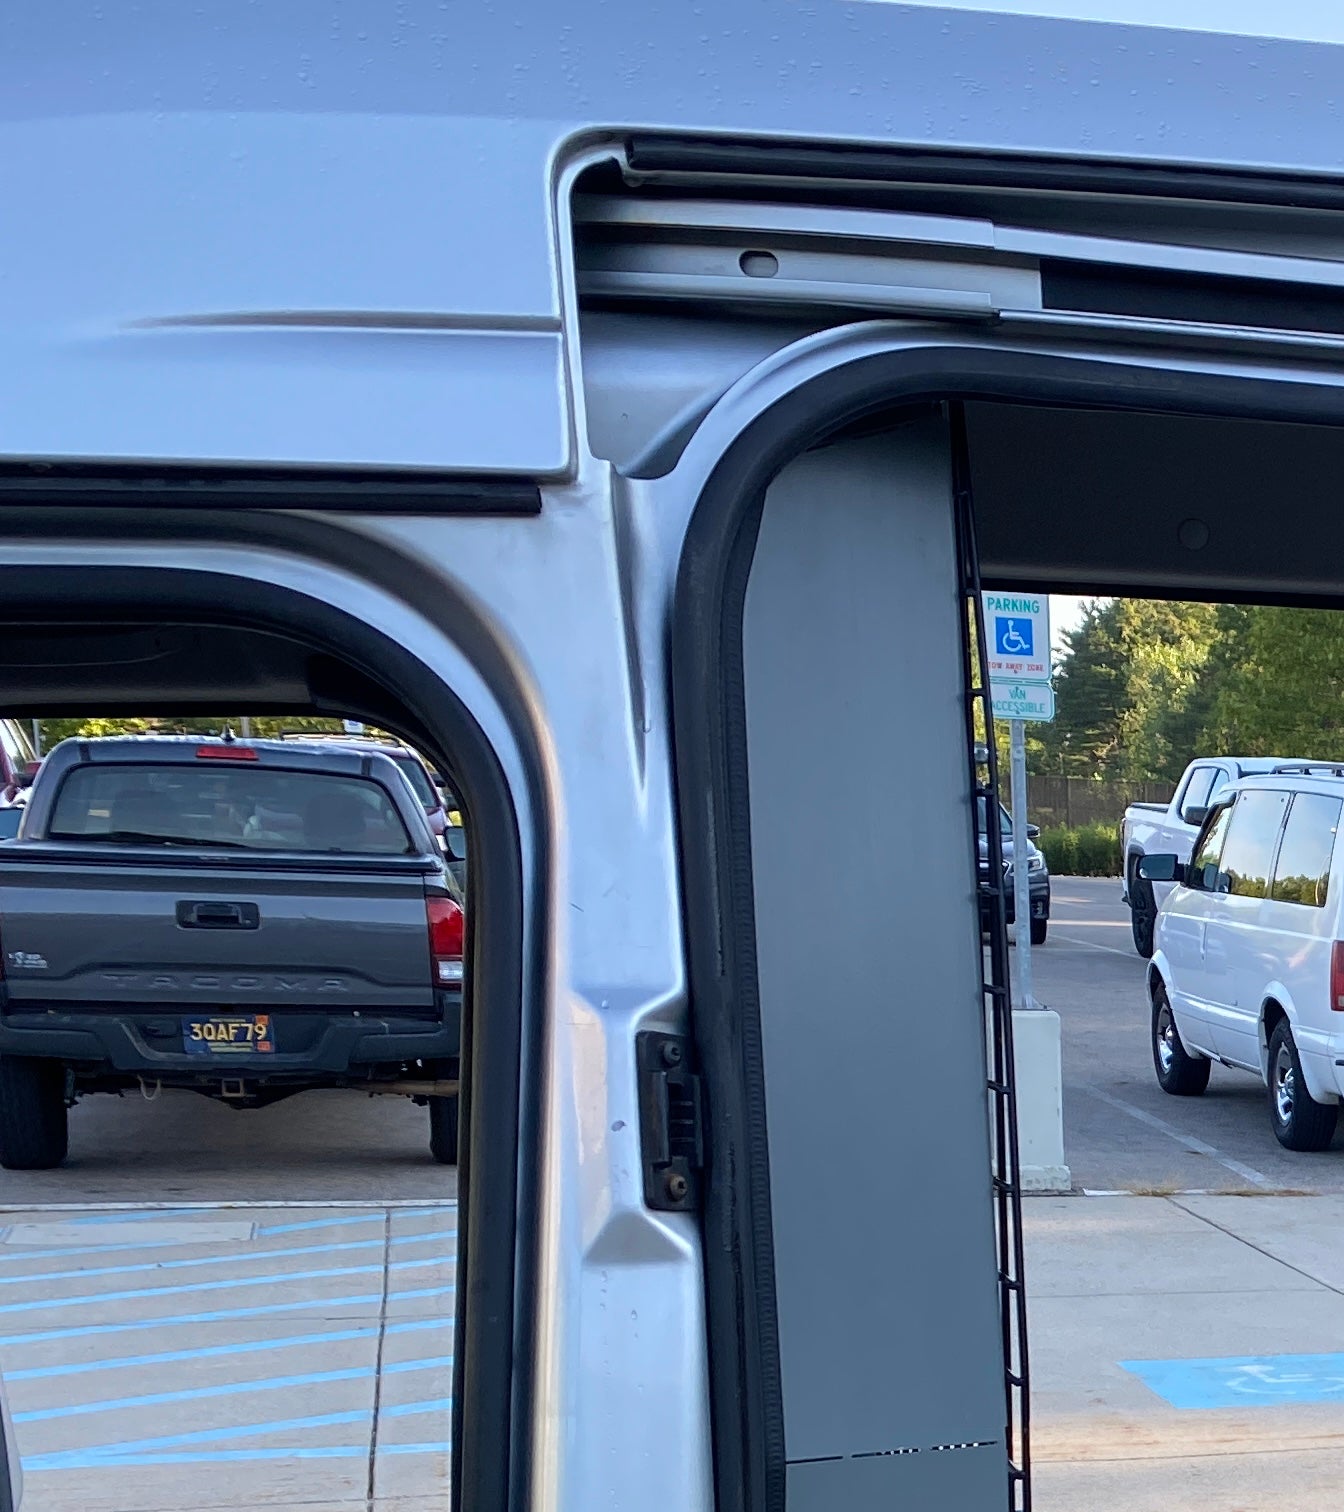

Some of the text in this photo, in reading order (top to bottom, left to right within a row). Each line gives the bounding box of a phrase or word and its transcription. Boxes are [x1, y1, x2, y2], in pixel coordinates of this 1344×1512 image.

[987, 597, 1040, 613] PARKING
[1008, 688, 1026, 699] VAN
[102, 973, 349, 992] TACOMA
